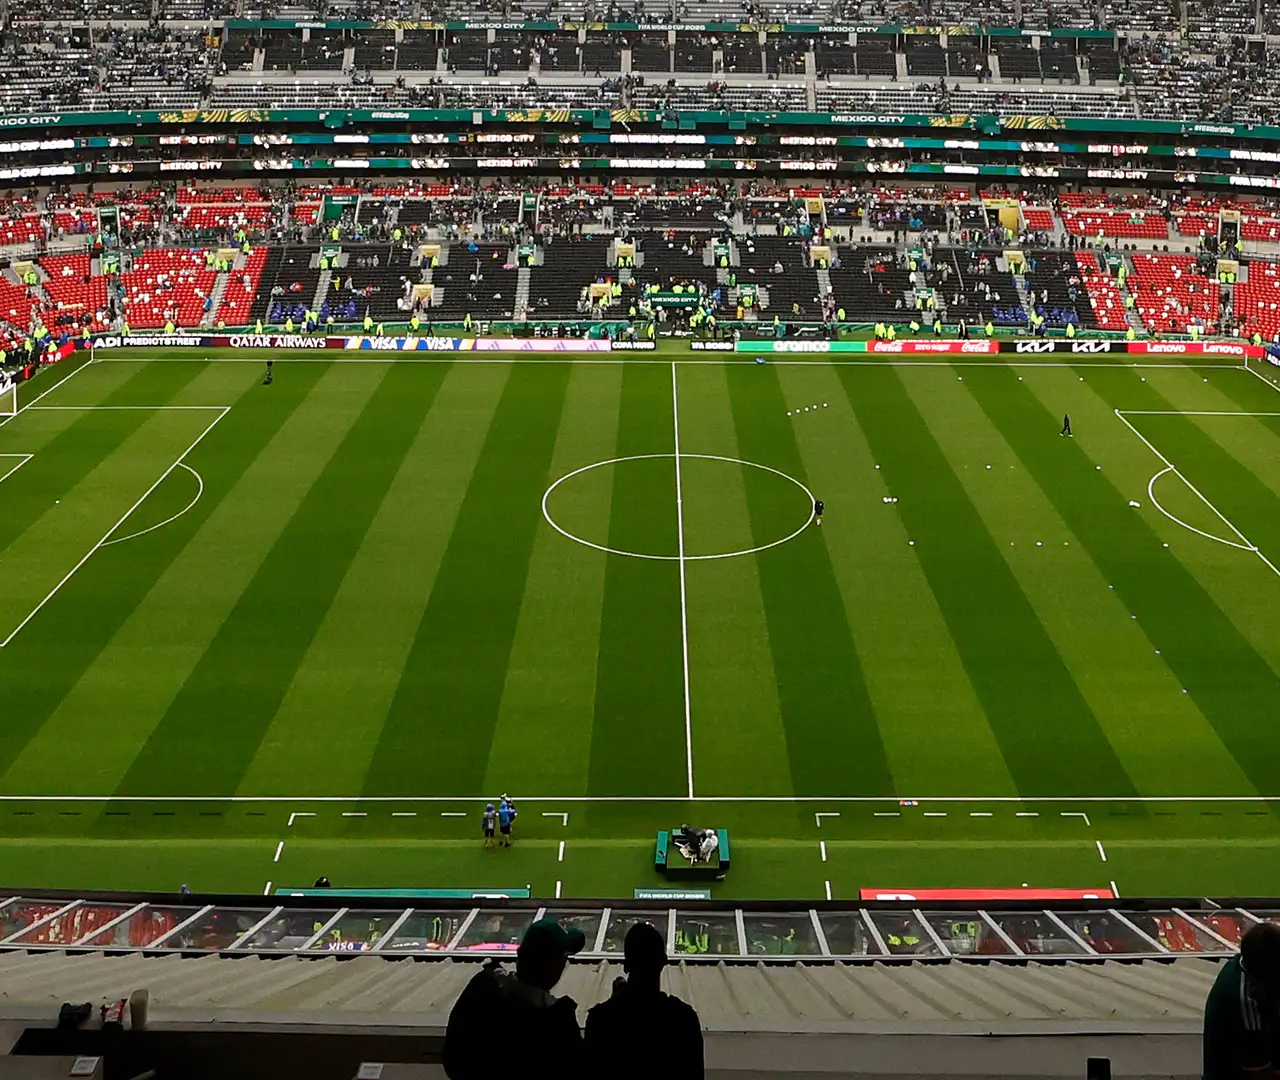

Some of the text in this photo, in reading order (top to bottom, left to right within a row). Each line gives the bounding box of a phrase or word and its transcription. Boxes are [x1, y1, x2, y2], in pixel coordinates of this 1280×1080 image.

[29, 116, 61, 126] CITY
[831, 115, 876, 123] MEXICO
[94, 337, 121, 349] ADI
[229, 336, 326, 348] QATAR AIRWAYS
[372, 336, 398, 350] VISA
[426, 338, 455, 350] VISA
[774, 340, 830, 352] aramco
[1147, 342, 1186, 353] Lenovo
[1202, 343, 1244, 355] Lenovo
